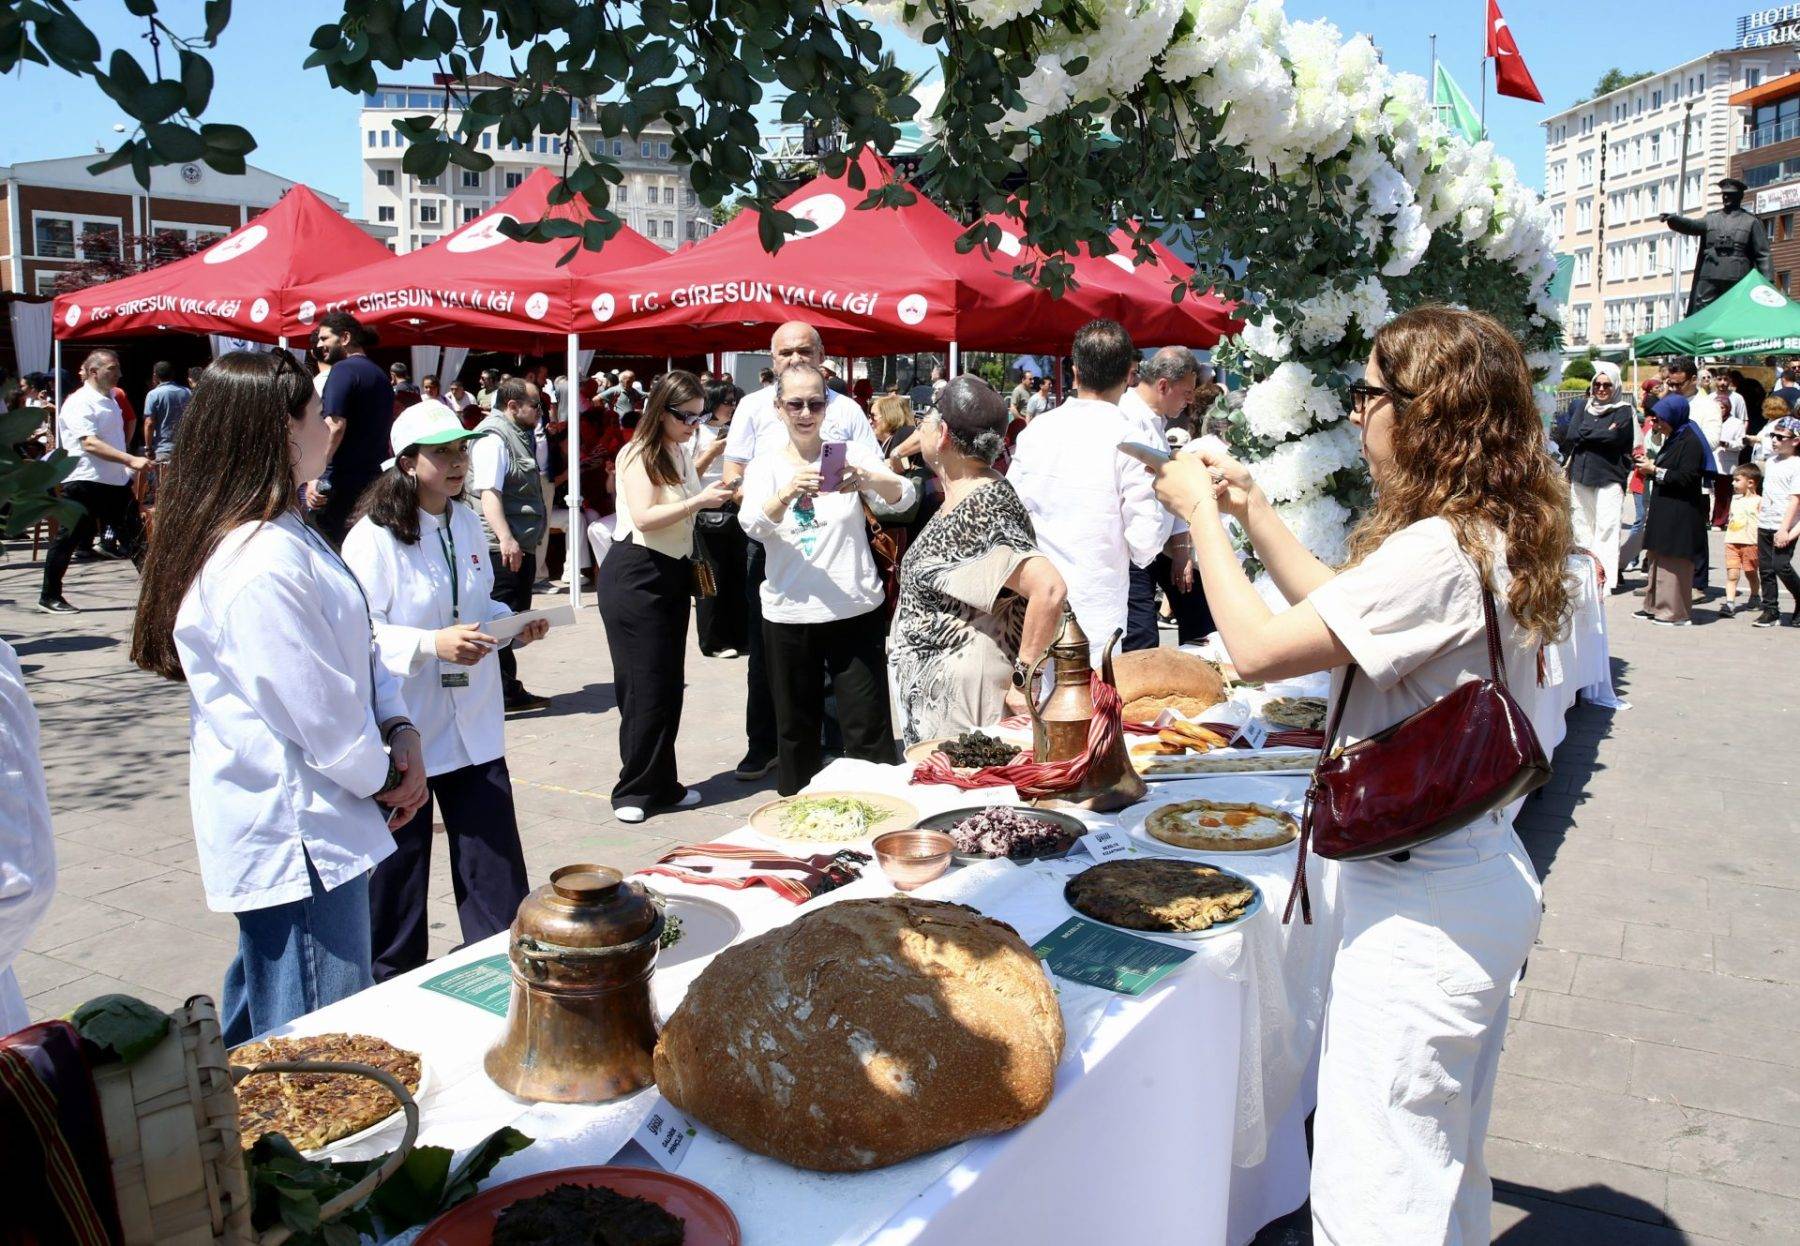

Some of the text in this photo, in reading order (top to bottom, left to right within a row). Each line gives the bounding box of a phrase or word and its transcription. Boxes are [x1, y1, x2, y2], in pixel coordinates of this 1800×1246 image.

[91, 306, 112, 321] T.C.
[115, 295, 177, 316] GİRESUN
[357, 289, 433, 313] GİRESUN
[436, 289, 515, 313] VALİLİĞİ
[628, 280, 879, 316] T.C. GİRESUN VALİLİĞİ
